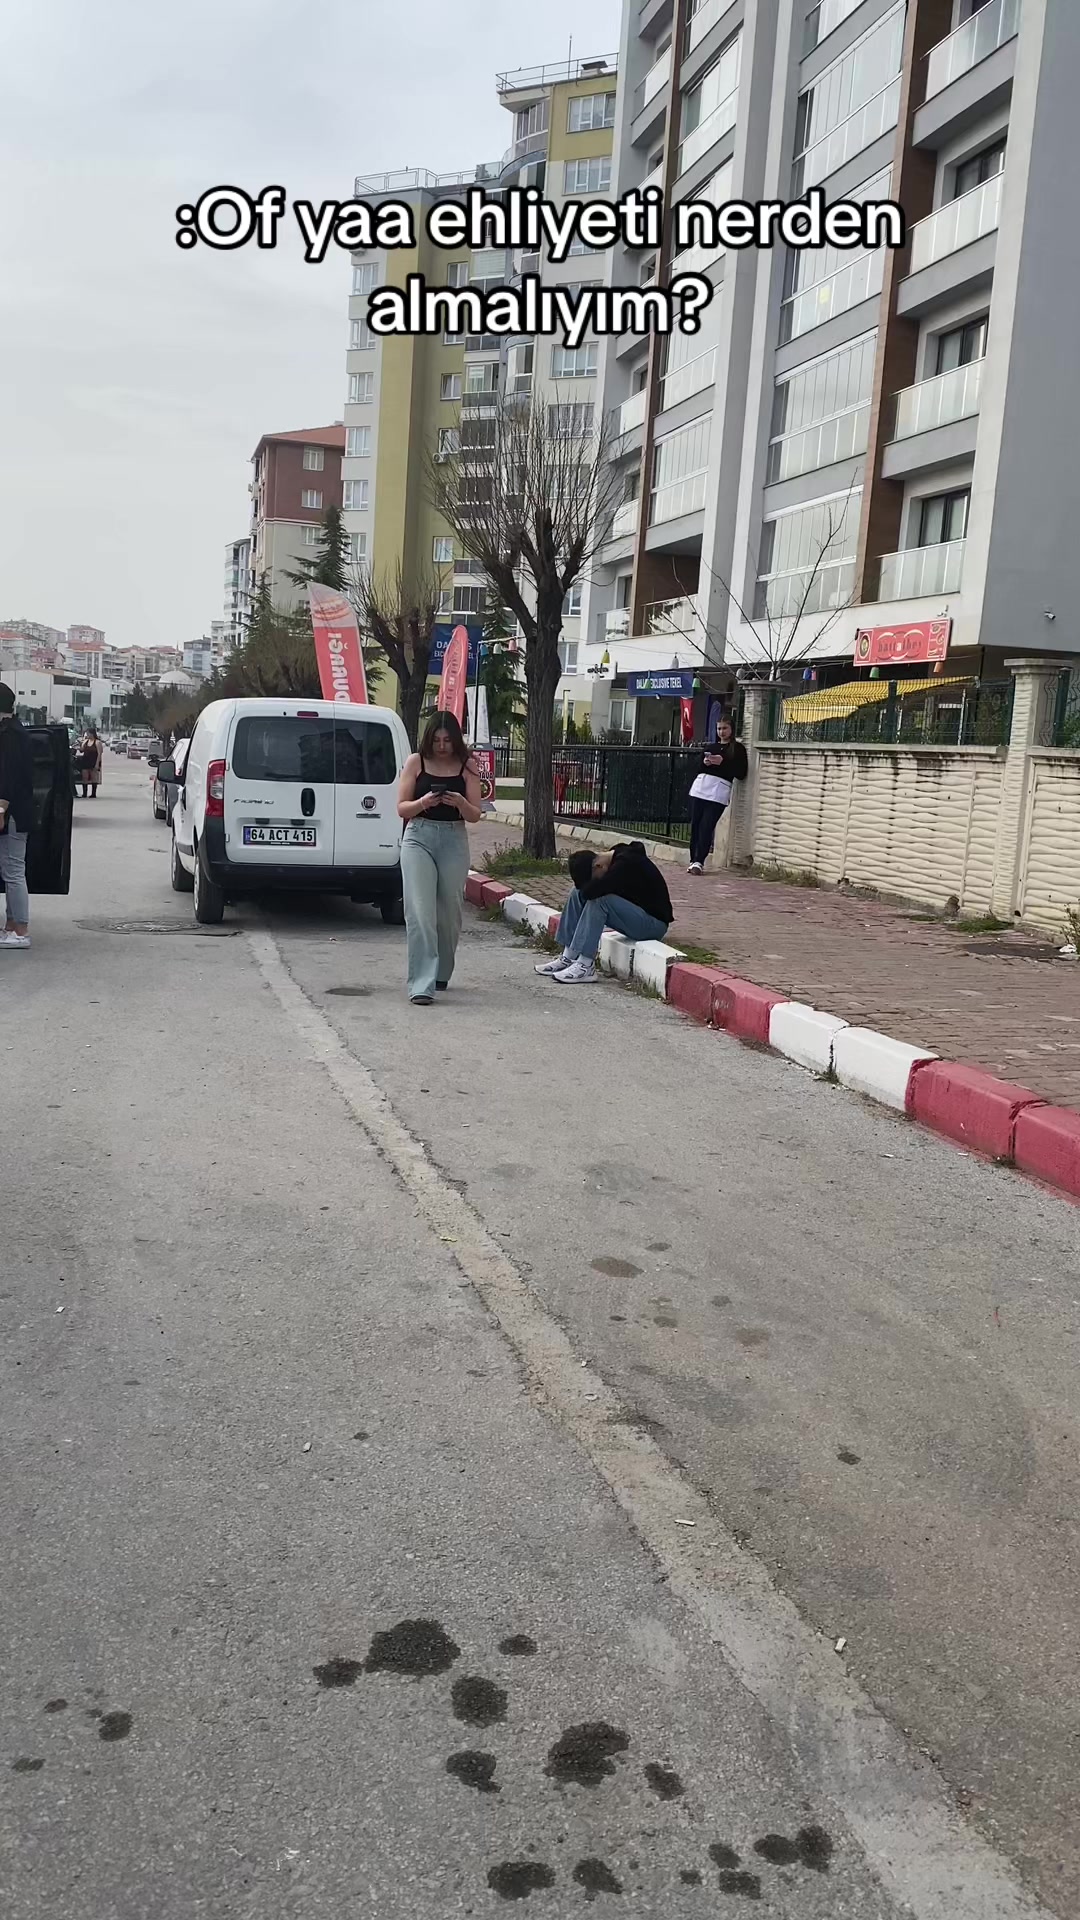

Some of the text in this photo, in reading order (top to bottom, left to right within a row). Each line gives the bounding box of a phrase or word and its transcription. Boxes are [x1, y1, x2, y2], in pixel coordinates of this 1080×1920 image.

[251, 829, 265, 840] 64
[269, 829, 290, 841] ACT
[292, 830, 313, 841] 415
